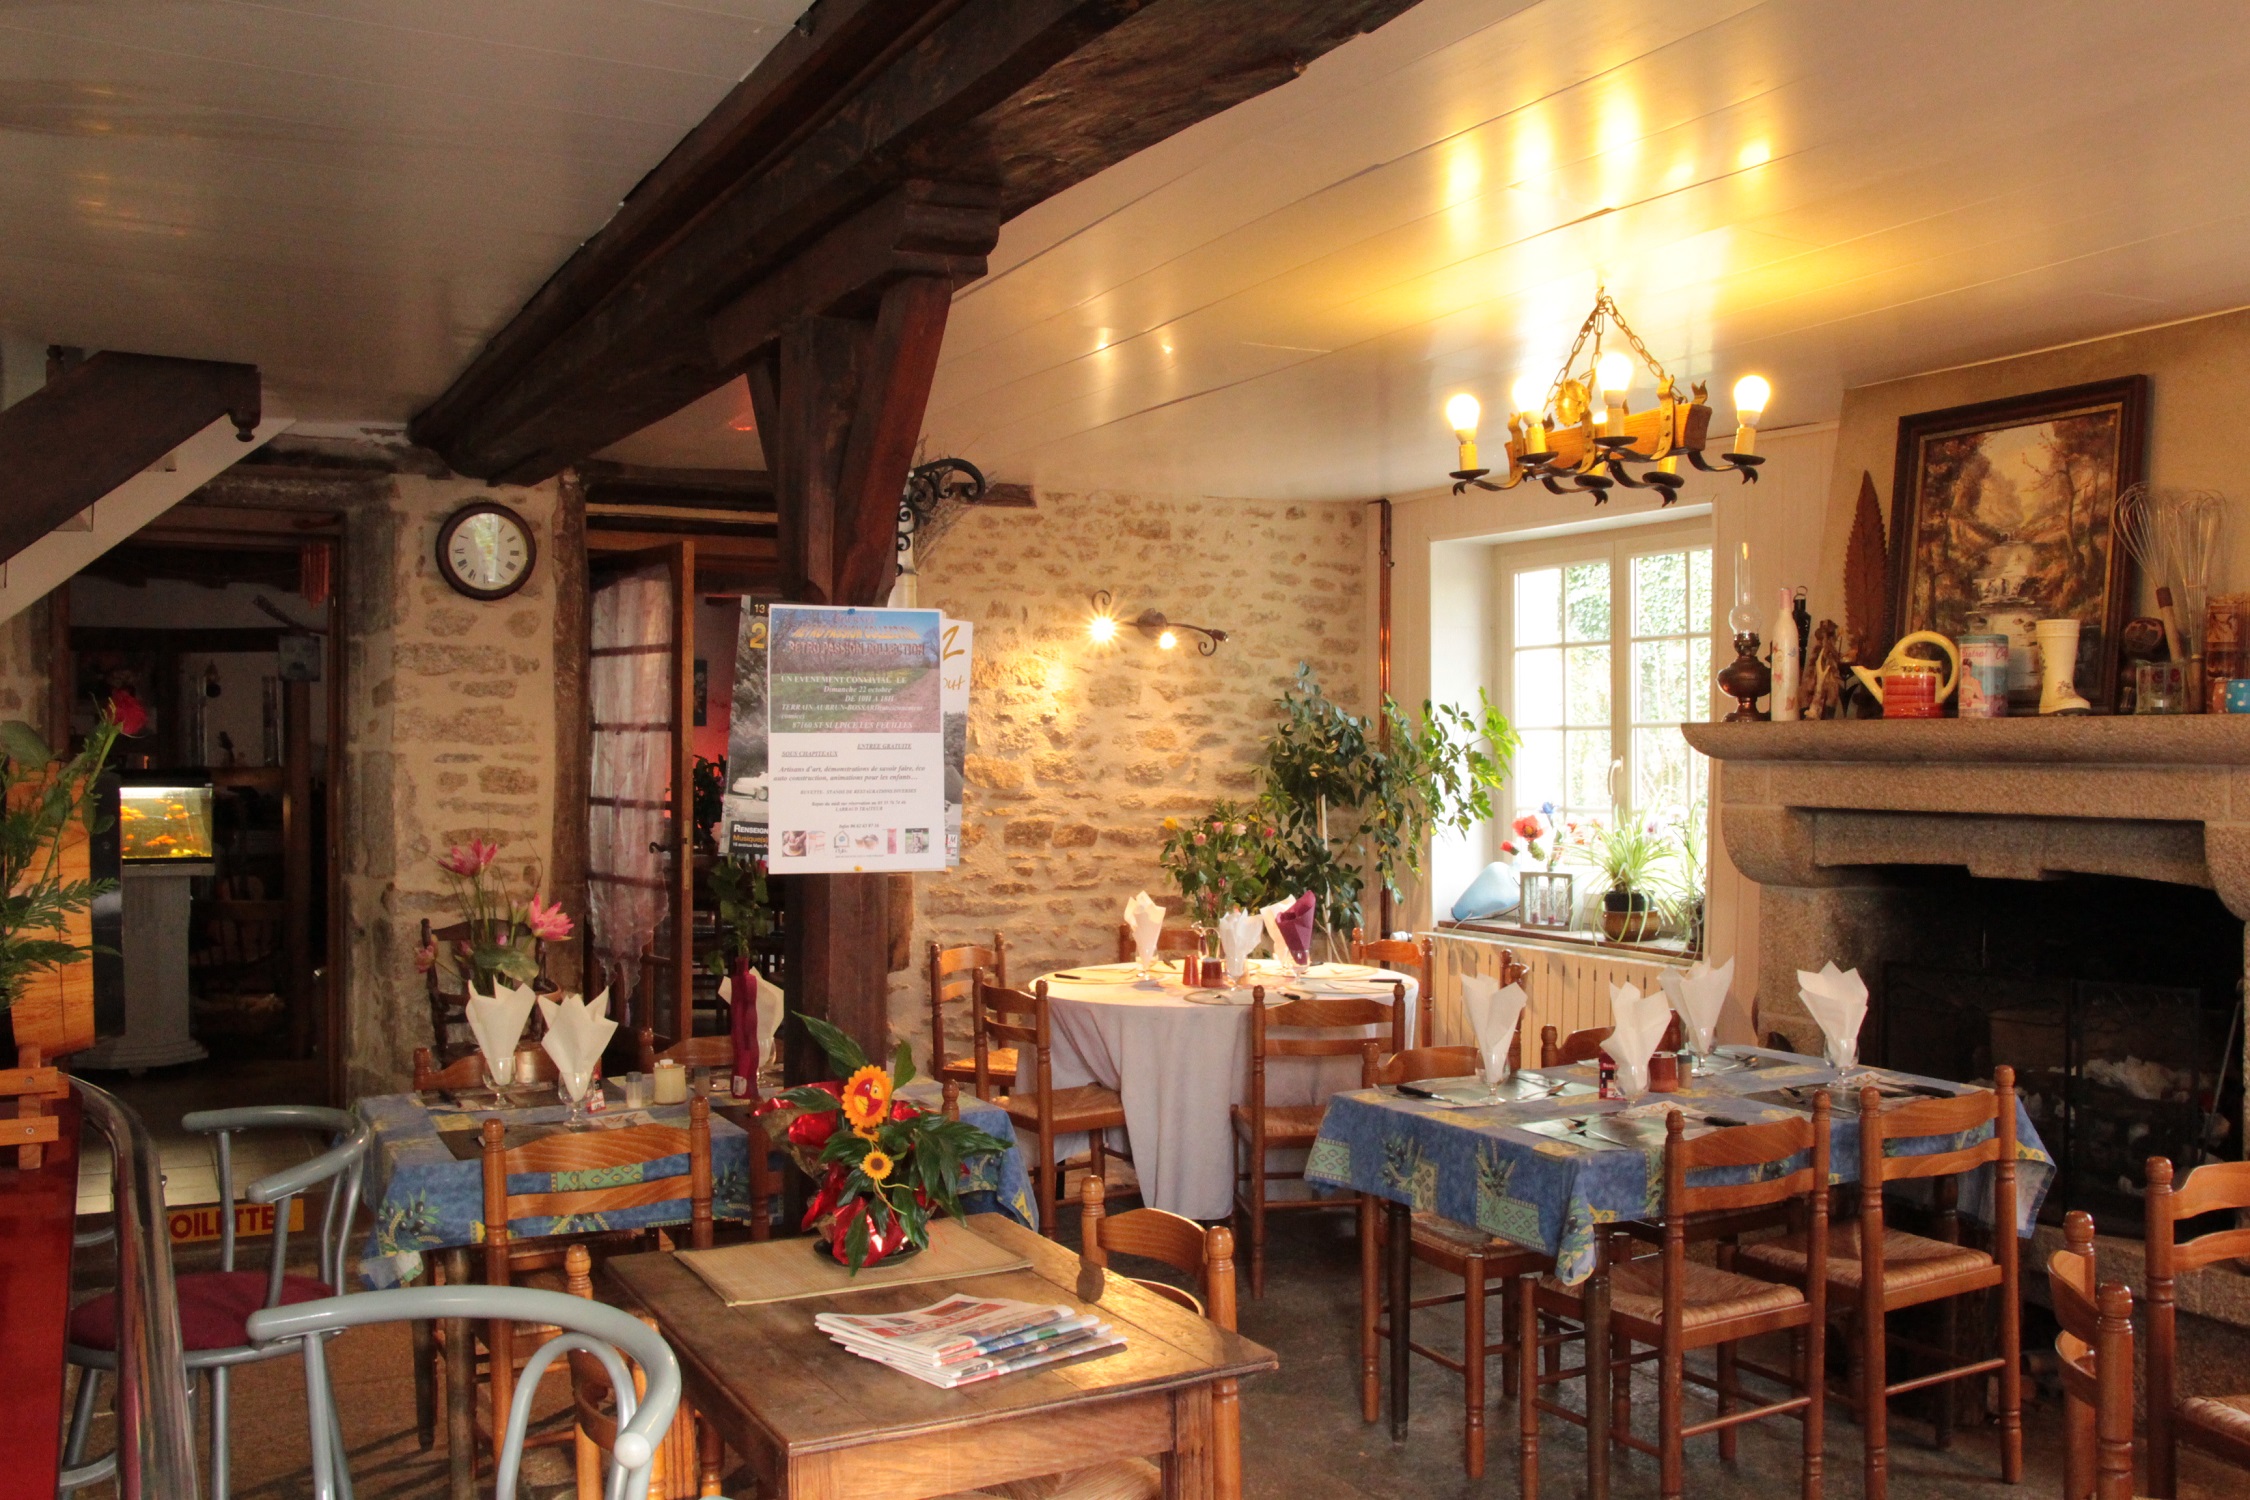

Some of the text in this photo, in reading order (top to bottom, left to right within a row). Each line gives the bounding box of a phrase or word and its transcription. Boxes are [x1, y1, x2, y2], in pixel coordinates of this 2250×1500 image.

[788, 641, 819, 655] RETRO
[820, 641, 865, 656] PASSION
[781, 675, 793, 683] UN
[794, 675, 845, 683] EVENEMENT
[823, 685, 858, 693] Dimanche
[858, 685, 867, 693] 22
[845, 694, 856, 702] DE
[781, 703, 814, 711] TERRAIN
[825, 721, 858, 729] SULPICE
[824, 765, 870, 773] démonstrations
